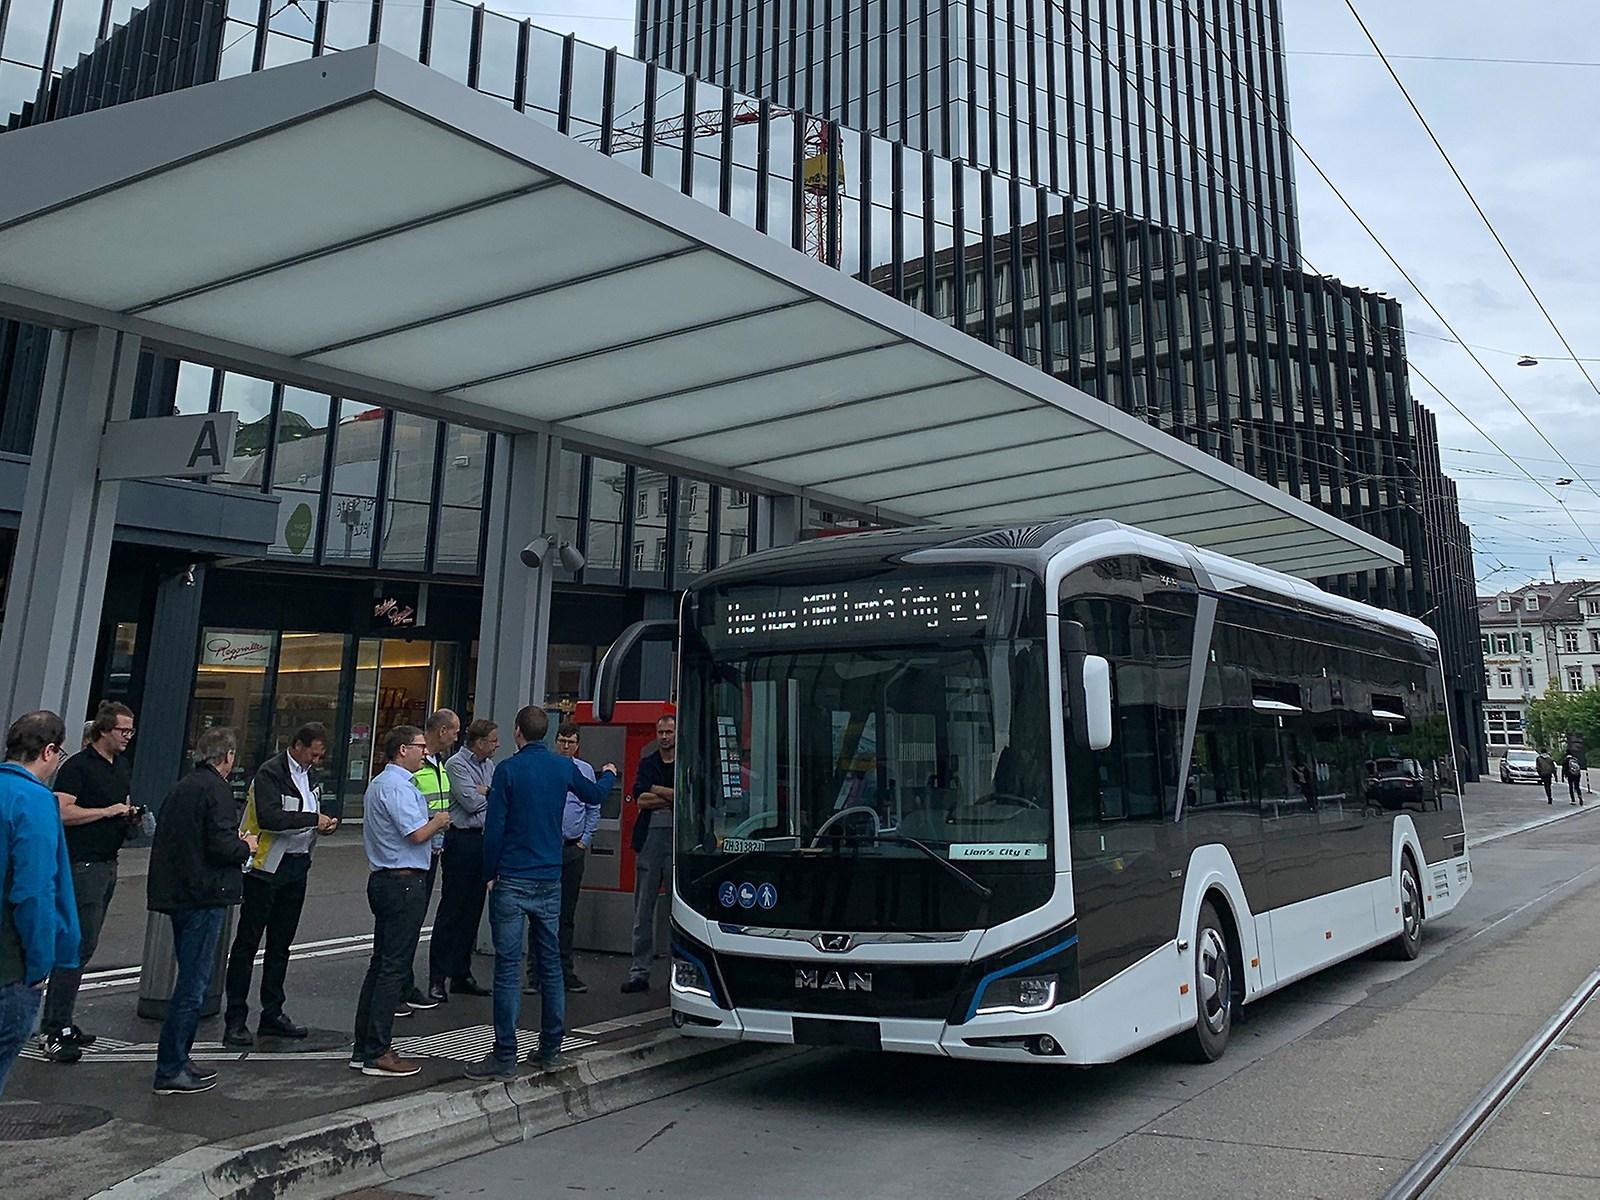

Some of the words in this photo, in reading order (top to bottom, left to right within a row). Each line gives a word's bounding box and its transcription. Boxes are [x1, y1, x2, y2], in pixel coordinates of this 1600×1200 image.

[186, 420, 221, 468] A
[963, 848, 995, 857] Lion's
[999, 848, 1021, 858] City
[1024, 848, 1032, 857] E
[794, 968, 873, 993] MAN
